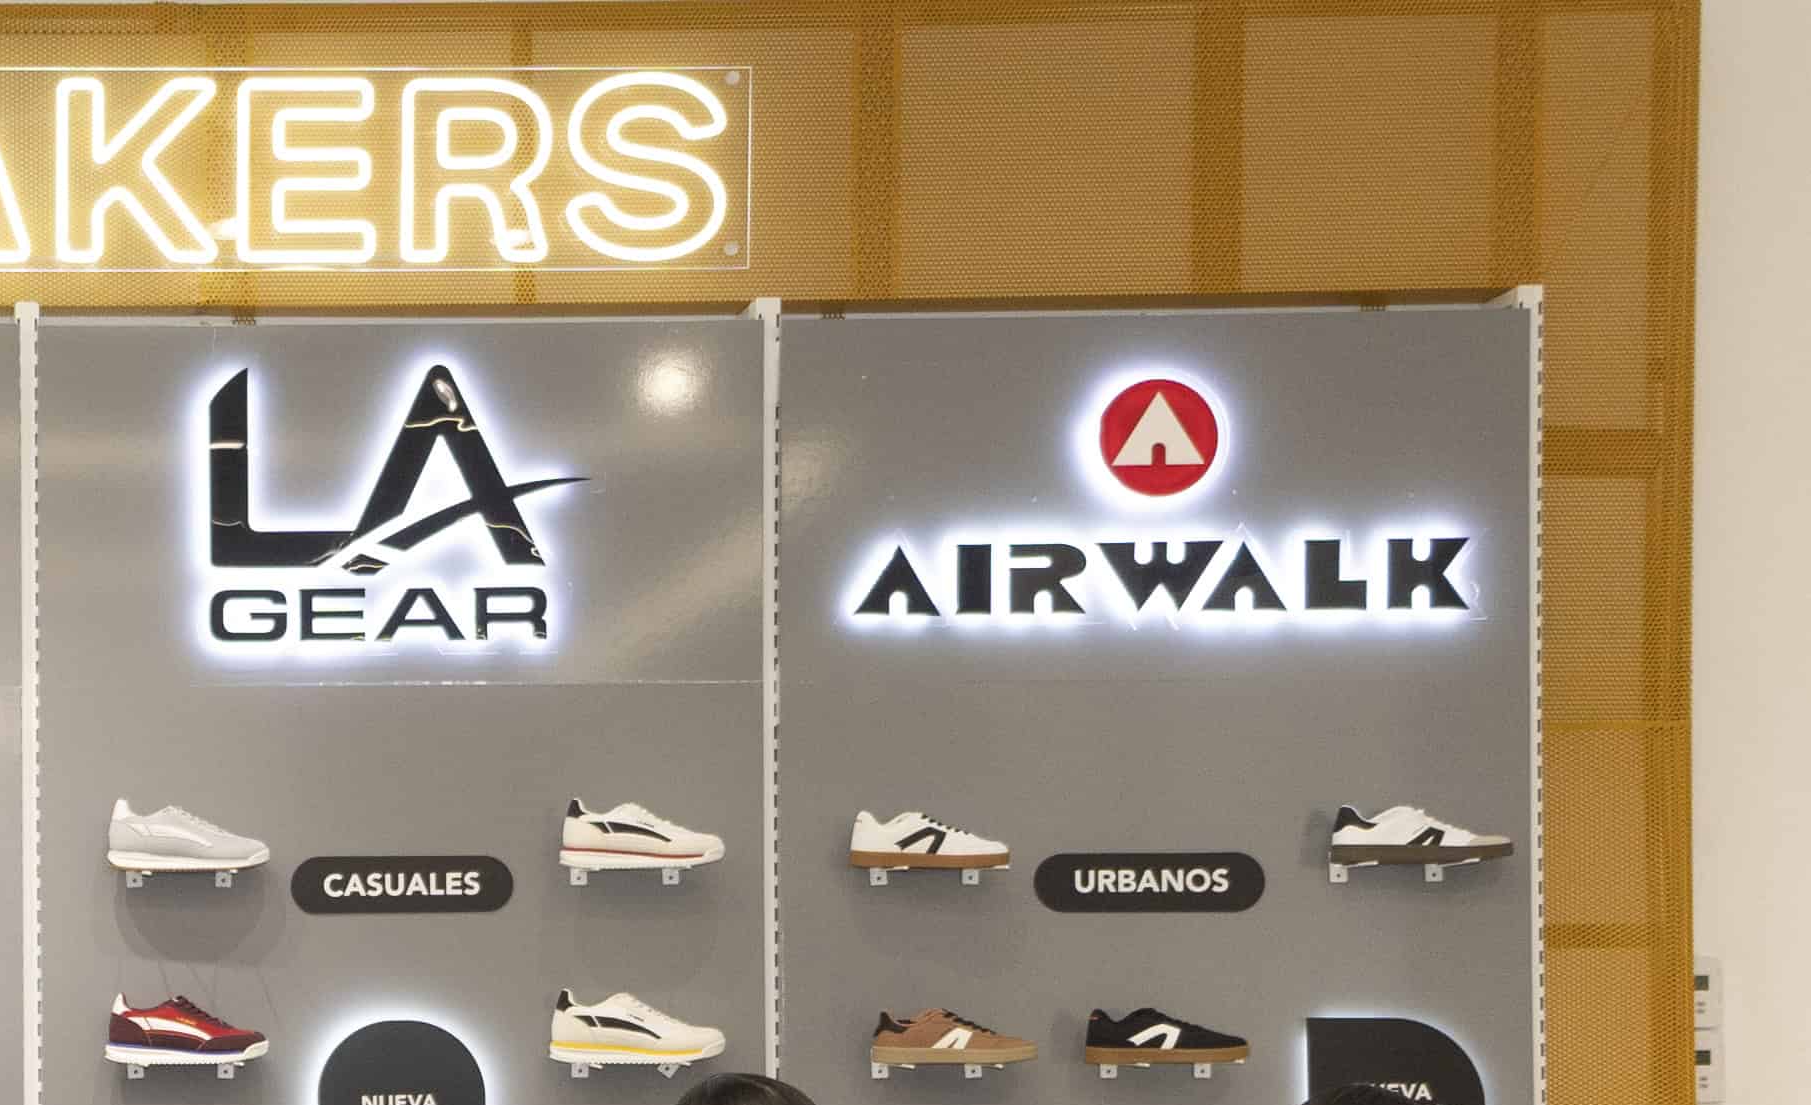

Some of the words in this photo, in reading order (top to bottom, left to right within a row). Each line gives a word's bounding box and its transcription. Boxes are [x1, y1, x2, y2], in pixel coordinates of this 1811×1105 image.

[210, 364, 591, 576] LA
[853, 537, 1471, 616] AIRWALK
[210, 586, 548, 642] GEAR
[323, 872, 481, 898] CASUALES
[1073, 869, 1229, 894] URBANOS
